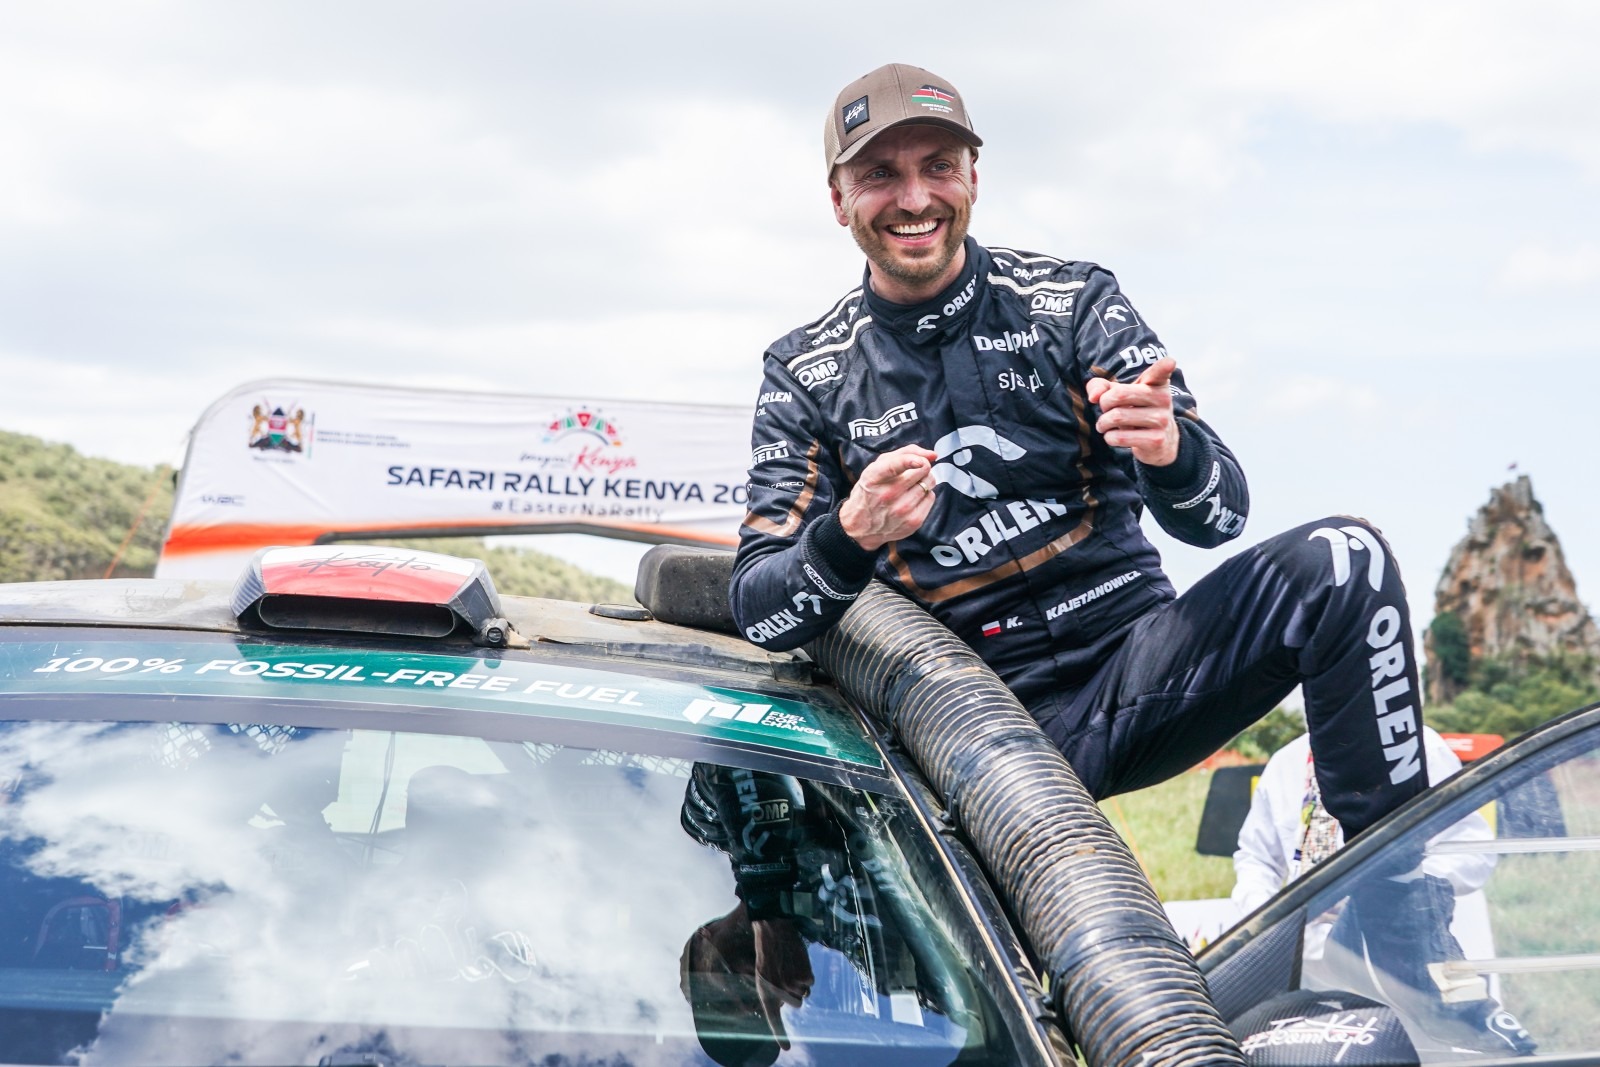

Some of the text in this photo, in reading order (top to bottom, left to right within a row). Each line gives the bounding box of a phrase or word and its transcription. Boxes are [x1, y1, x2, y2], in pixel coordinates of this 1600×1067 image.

[1030, 294, 1074, 312] OMP
[811, 320, 849, 346] ORLEN
[973, 324, 1040, 354] Delphi
[798, 359, 839, 386] OMP
[998, 367, 1044, 393] sjs.pl
[758, 391, 793, 406] ORLEN
[848, 402, 918, 440] PIRELLI
[387, 466, 750, 504] SAFARI RALLY KENYA 20
[929, 498, 1068, 567] ORLEN
[1006, 570, 1142, 630] K. KAJETANOWICZ
[745, 608, 803, 643] ORLEN
[33, 657, 644, 707] 100% FOSSIL-FREE FUEL
[1366, 605, 1421, 786] ORLEN
[761, 719, 826, 736] CHANGE
[765, 715, 798, 726] FOR
[769, 710, 807, 723] FUEL
[752, 802, 790, 822] OMP
